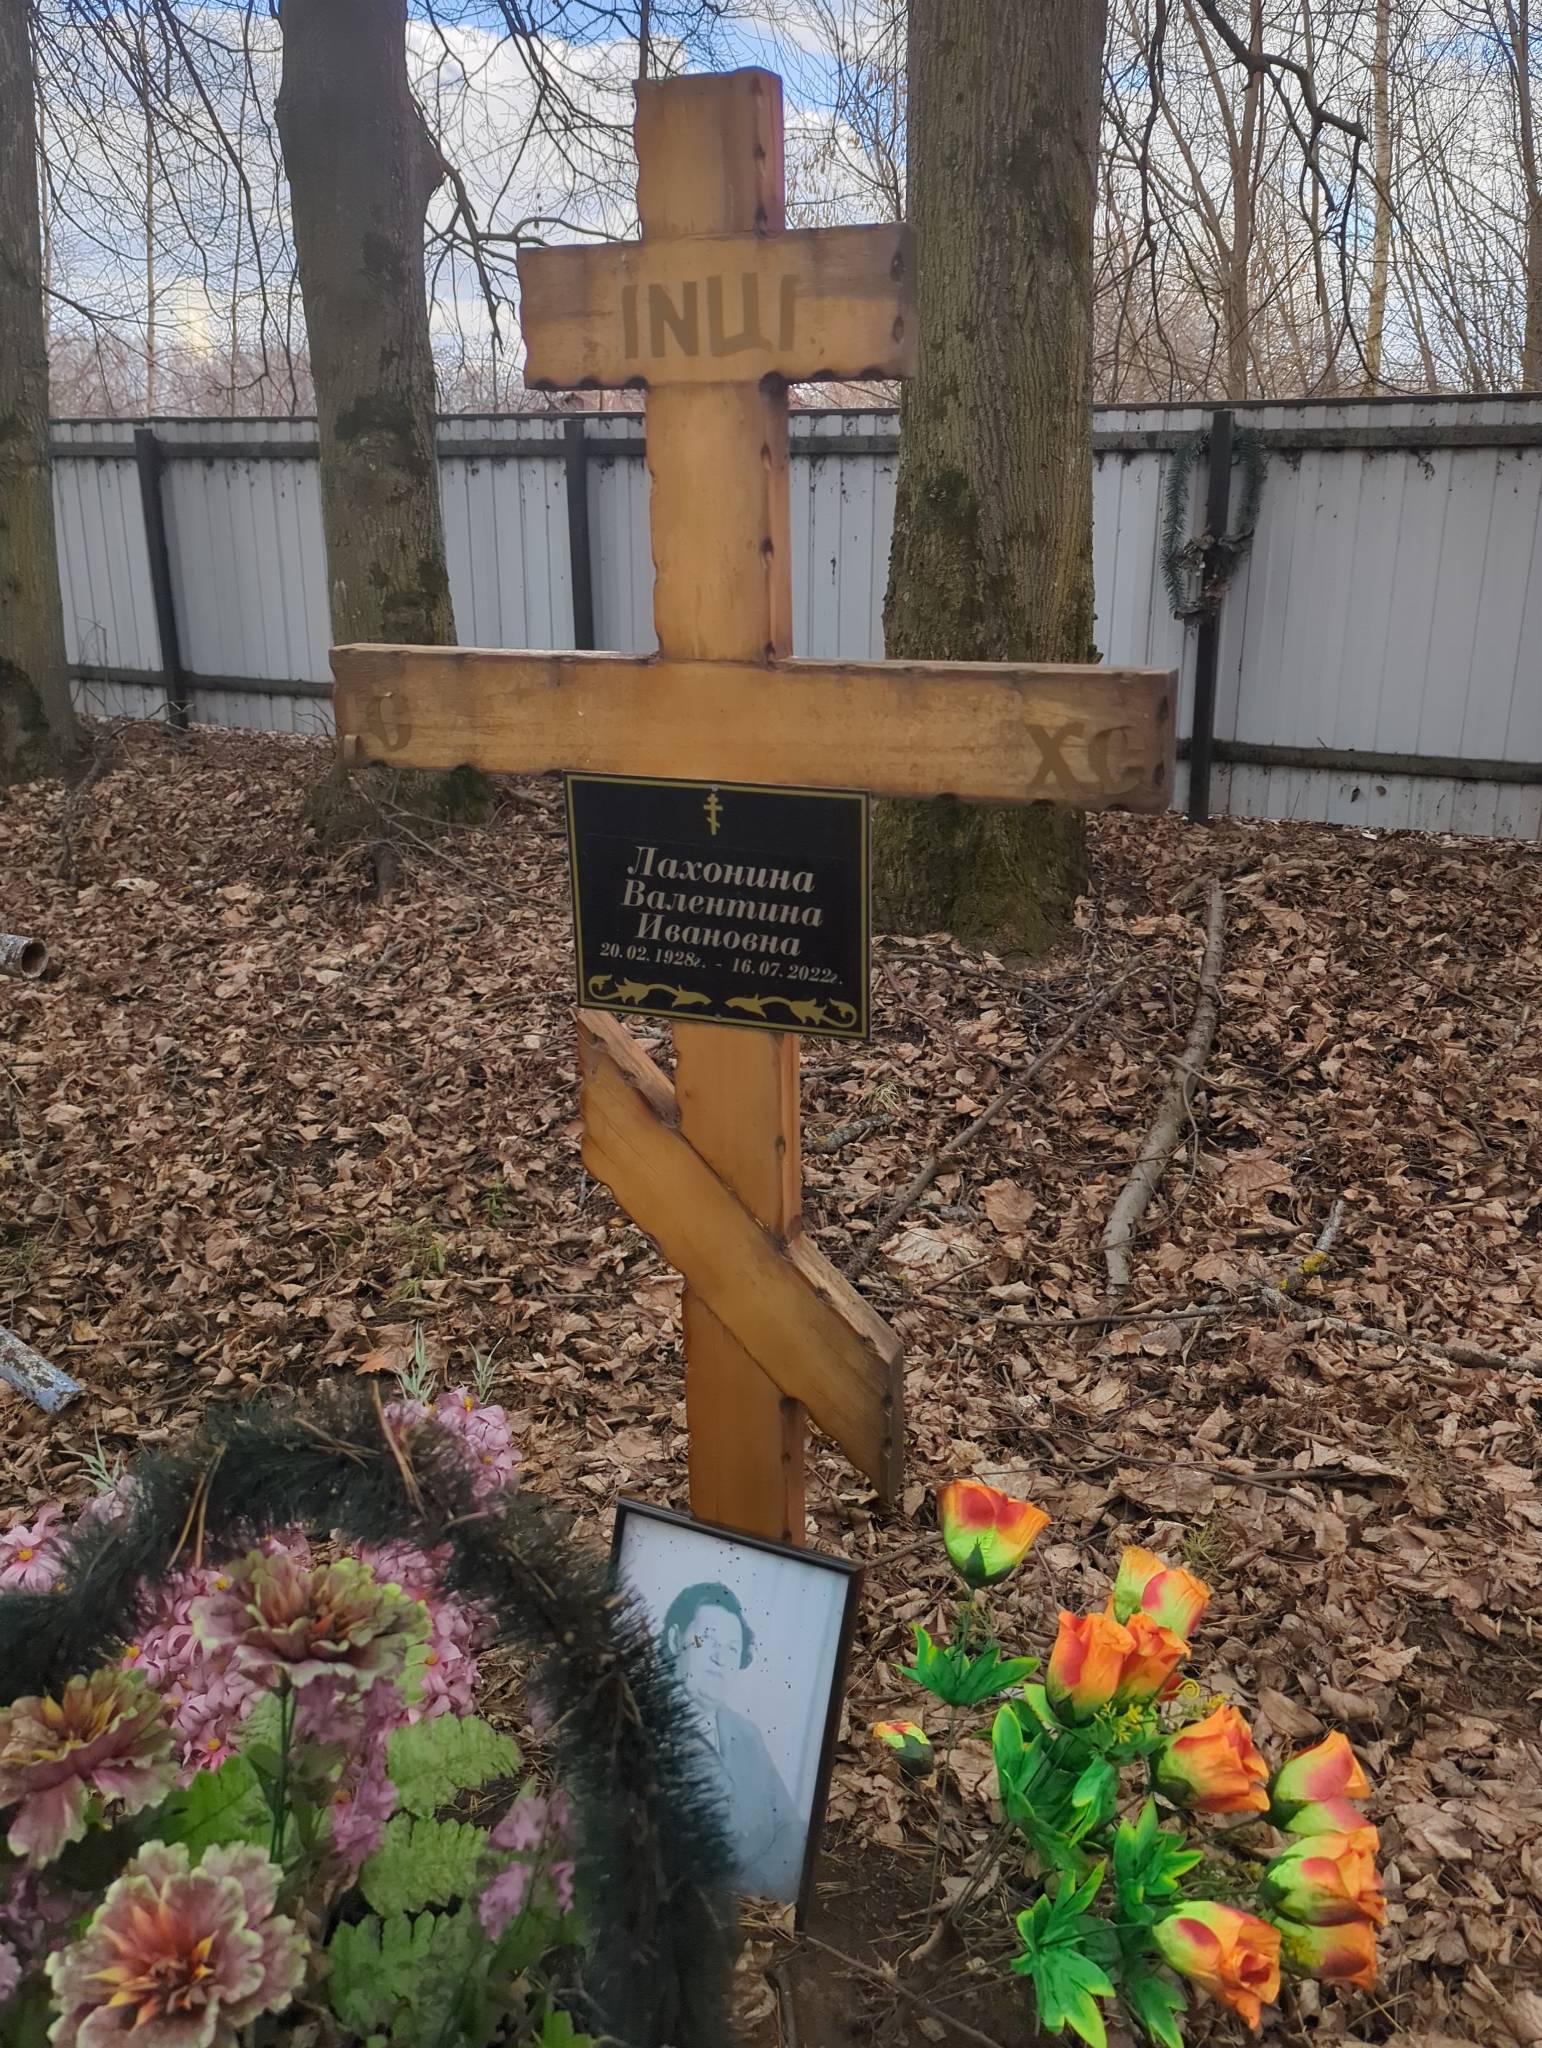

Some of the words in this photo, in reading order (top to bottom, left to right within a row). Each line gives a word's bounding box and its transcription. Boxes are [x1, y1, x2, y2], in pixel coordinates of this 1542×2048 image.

[626, 846, 816, 893] Лахонина
[620, 879, 824, 928] Валентина
[634, 912, 801, 957] Ивановна
